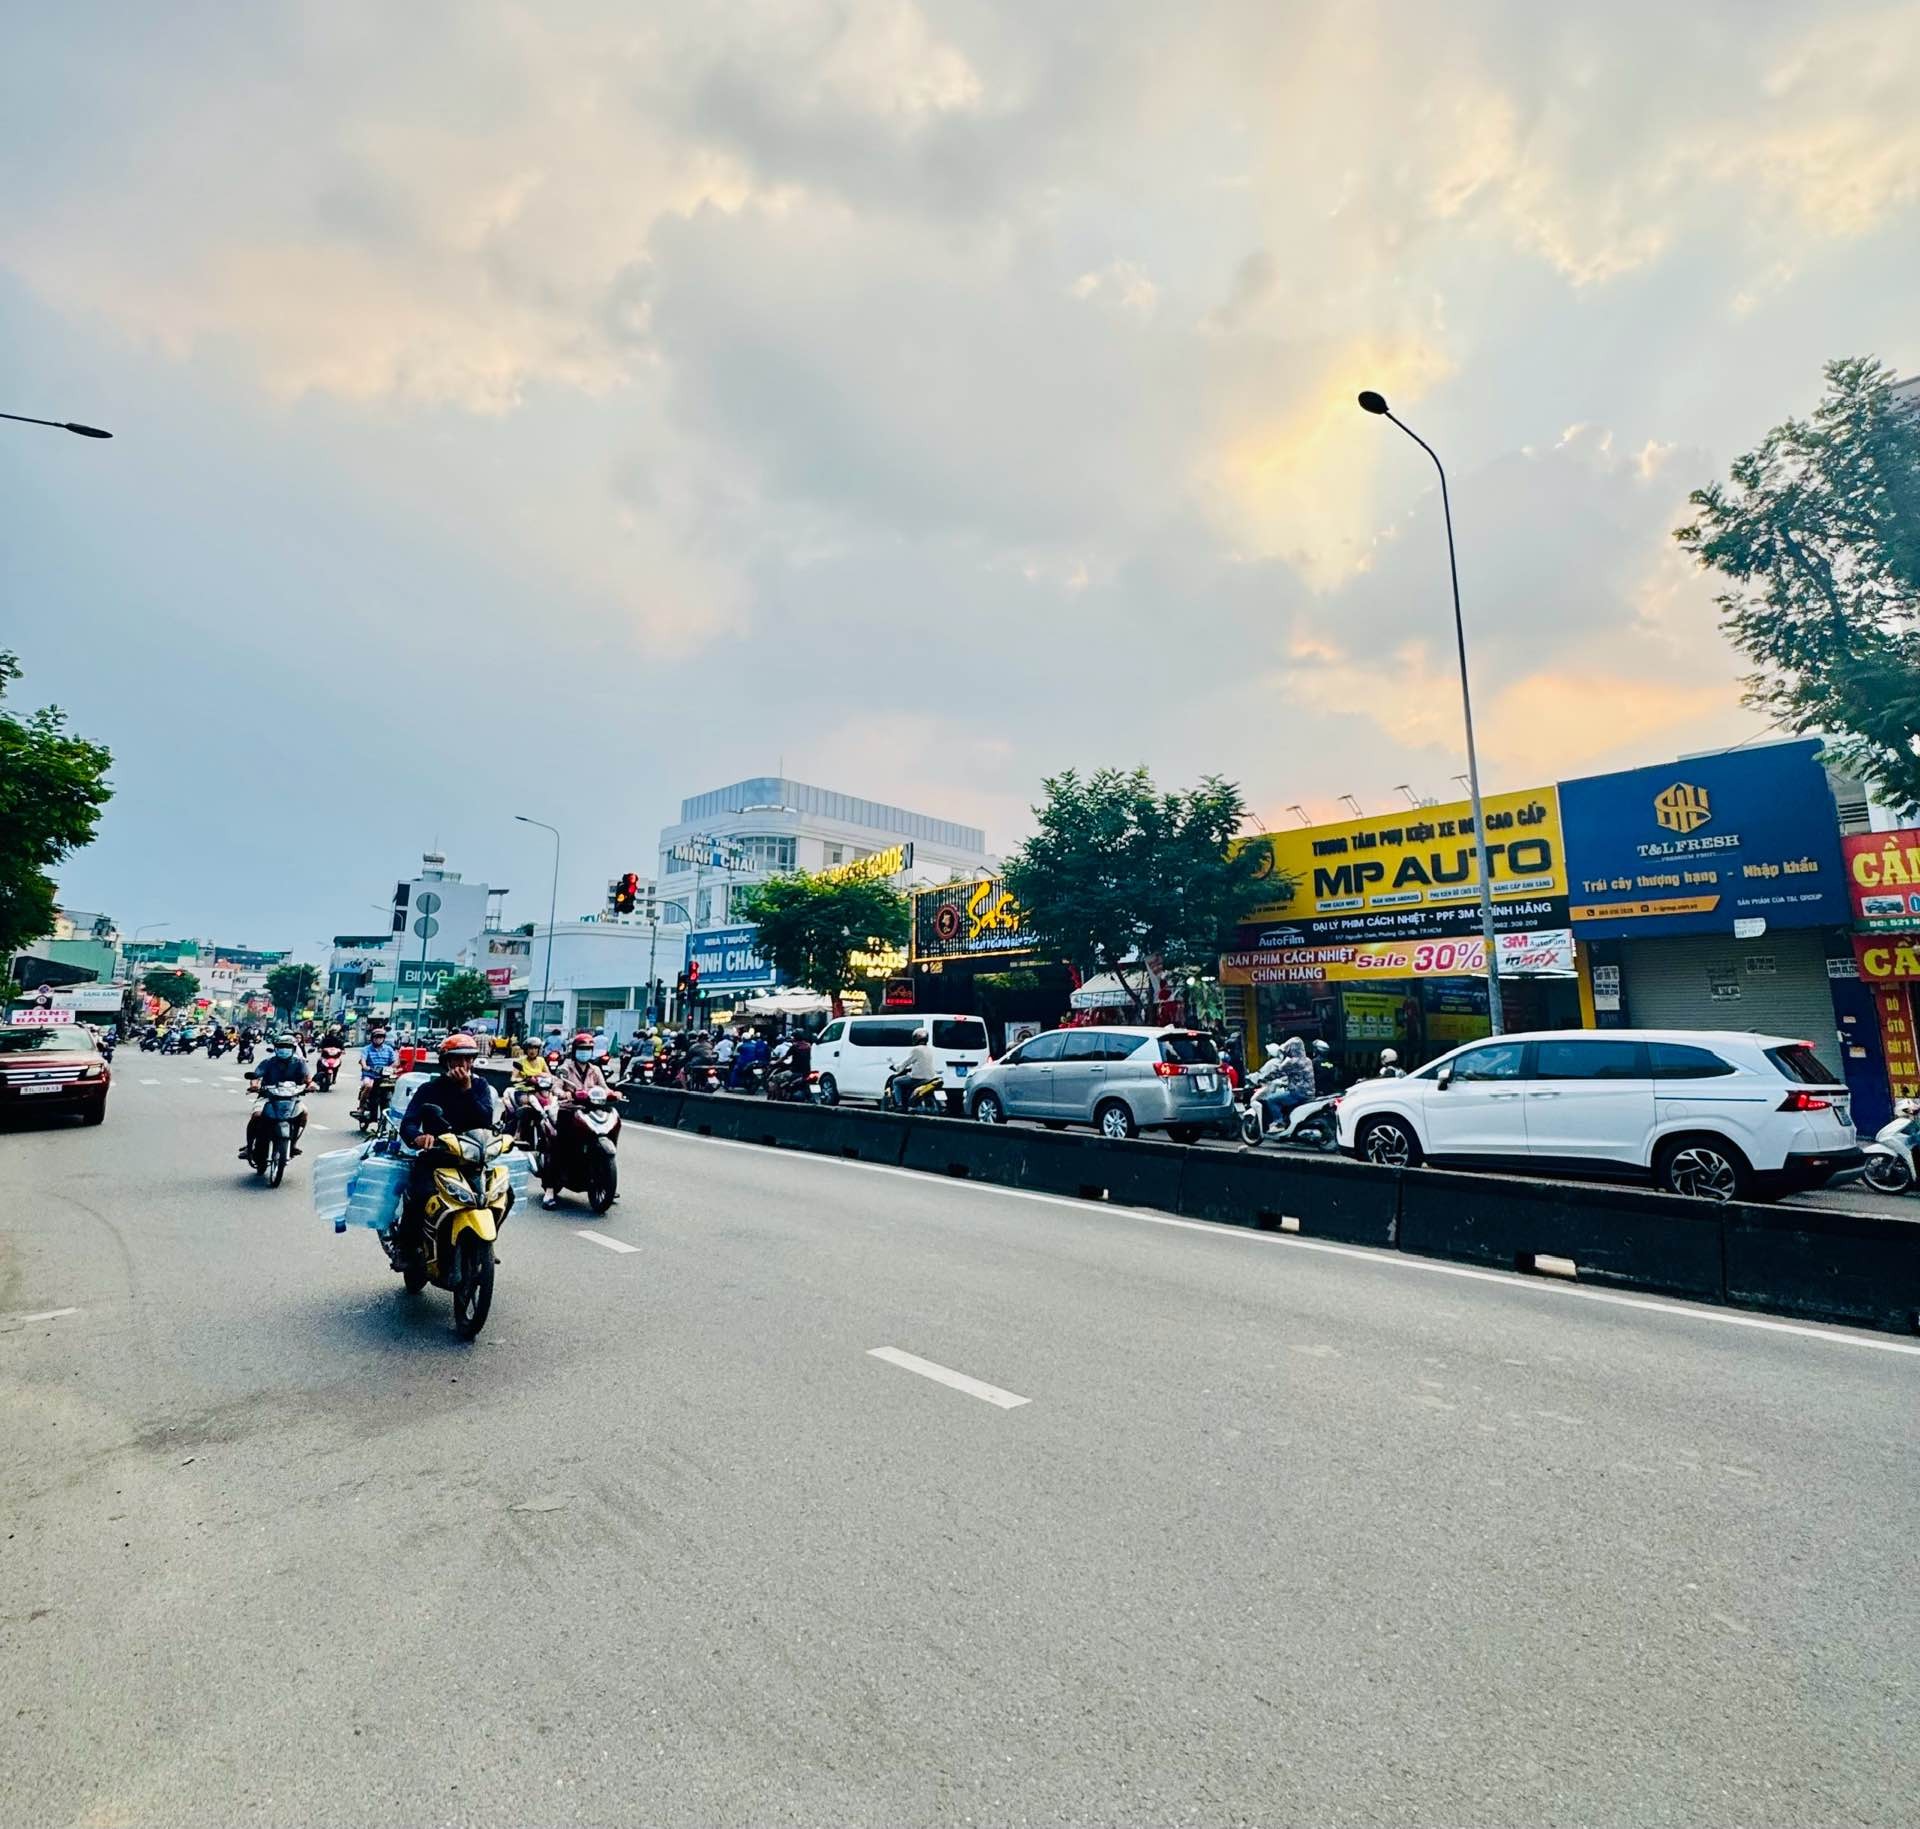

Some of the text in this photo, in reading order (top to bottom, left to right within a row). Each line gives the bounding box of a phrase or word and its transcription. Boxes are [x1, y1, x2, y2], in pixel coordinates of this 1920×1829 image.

[1438, 821, 1456, 838] XE
[1485, 811, 1513, 830] CAO
[1517, 801, 1546, 825] CẤP
[673, 844, 711, 866] MINH
[1637, 835, 1740, 857] T&L FRESH
[1314, 838, 1552, 897] MP AUTO
[1583, 878, 1608, 892] Trái
[1611, 877, 1632, 891] cây
[1637, 874, 1680, 888] thượng
[1684, 871, 1717, 885] hạng
[1743, 863, 1780, 879] Nhập
[1313, 922, 1328, 933] ĐẠI
[1329, 920, 1340, 931] LÝ
[1342, 920, 1364, 930] PHIM
[1367, 915, 1394, 927] CÁCH
[1397, 912, 1426, 925] NHIỆT
[1436, 911, 1455, 921] PPF
[1458, 909, 1474, 920] 3M
[1890, 918, 1910, 927] 521
[1259, 935, 1305, 947] AutoFilm
[1502, 936, 1528, 949] 3M
[850, 950, 908, 969] MOODS
[1252, 953, 1281, 966] PHIM
[1283, 949, 1315, 964] CÁCH
[1318, 945, 1355, 963] NHIỆT
[1357, 942, 1484, 971] Sale 30%
[405, 969, 437, 982] BIDV
[1251, 968, 1286, 982] CHÍNH
